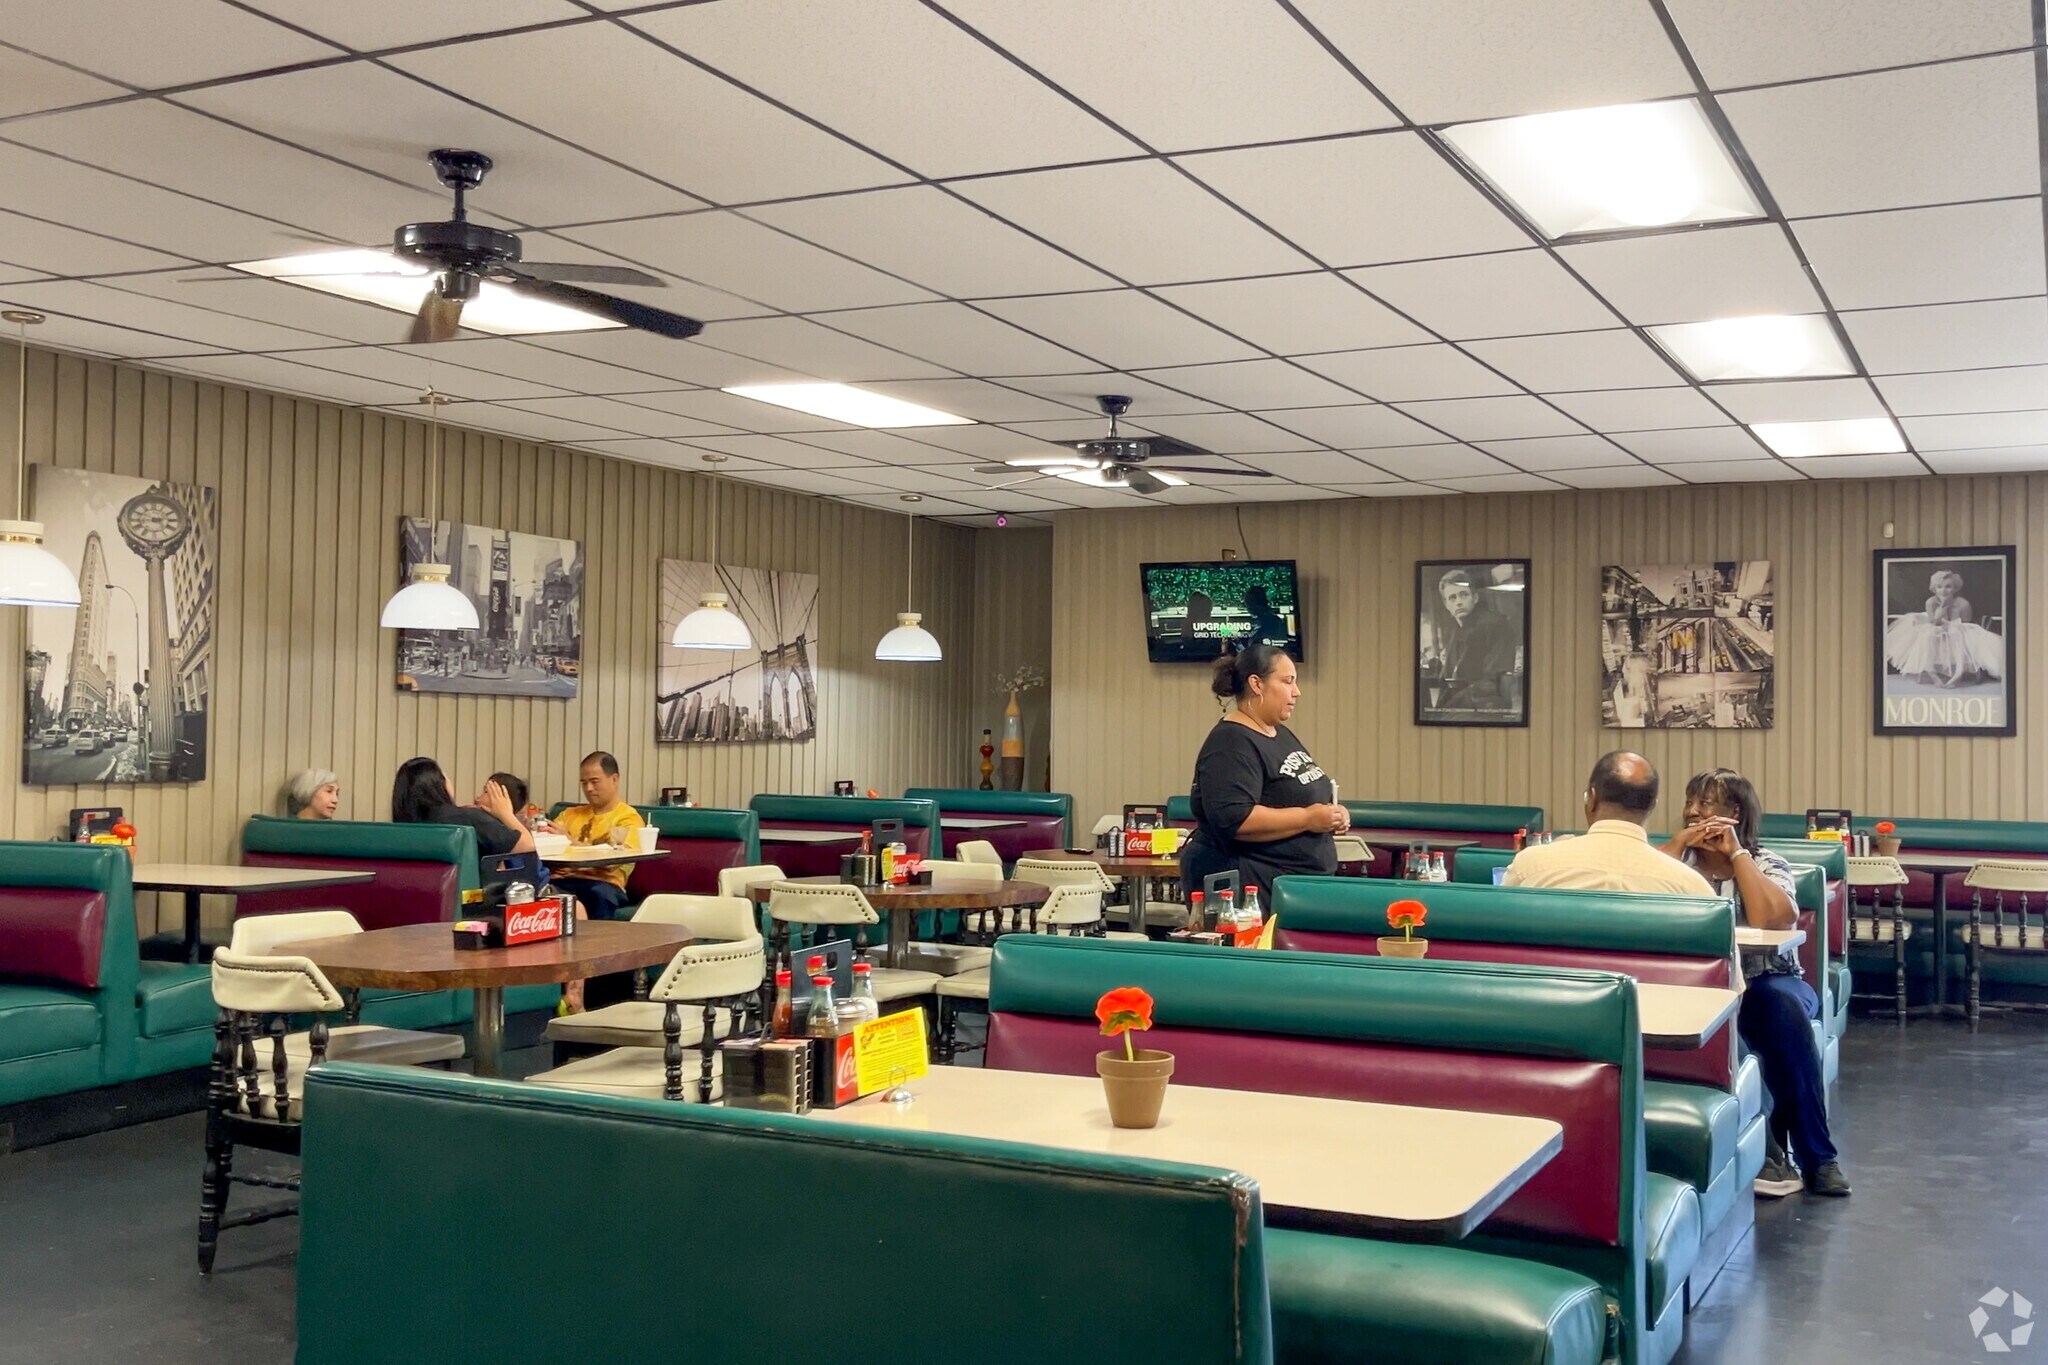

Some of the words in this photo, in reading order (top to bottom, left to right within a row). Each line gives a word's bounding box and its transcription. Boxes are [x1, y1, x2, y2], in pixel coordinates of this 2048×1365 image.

[1192, 622, 1252, 631] UPGRADING
[1885, 697, 2003, 726] MONROE
[508, 906, 559, 936] Coca-Cola
